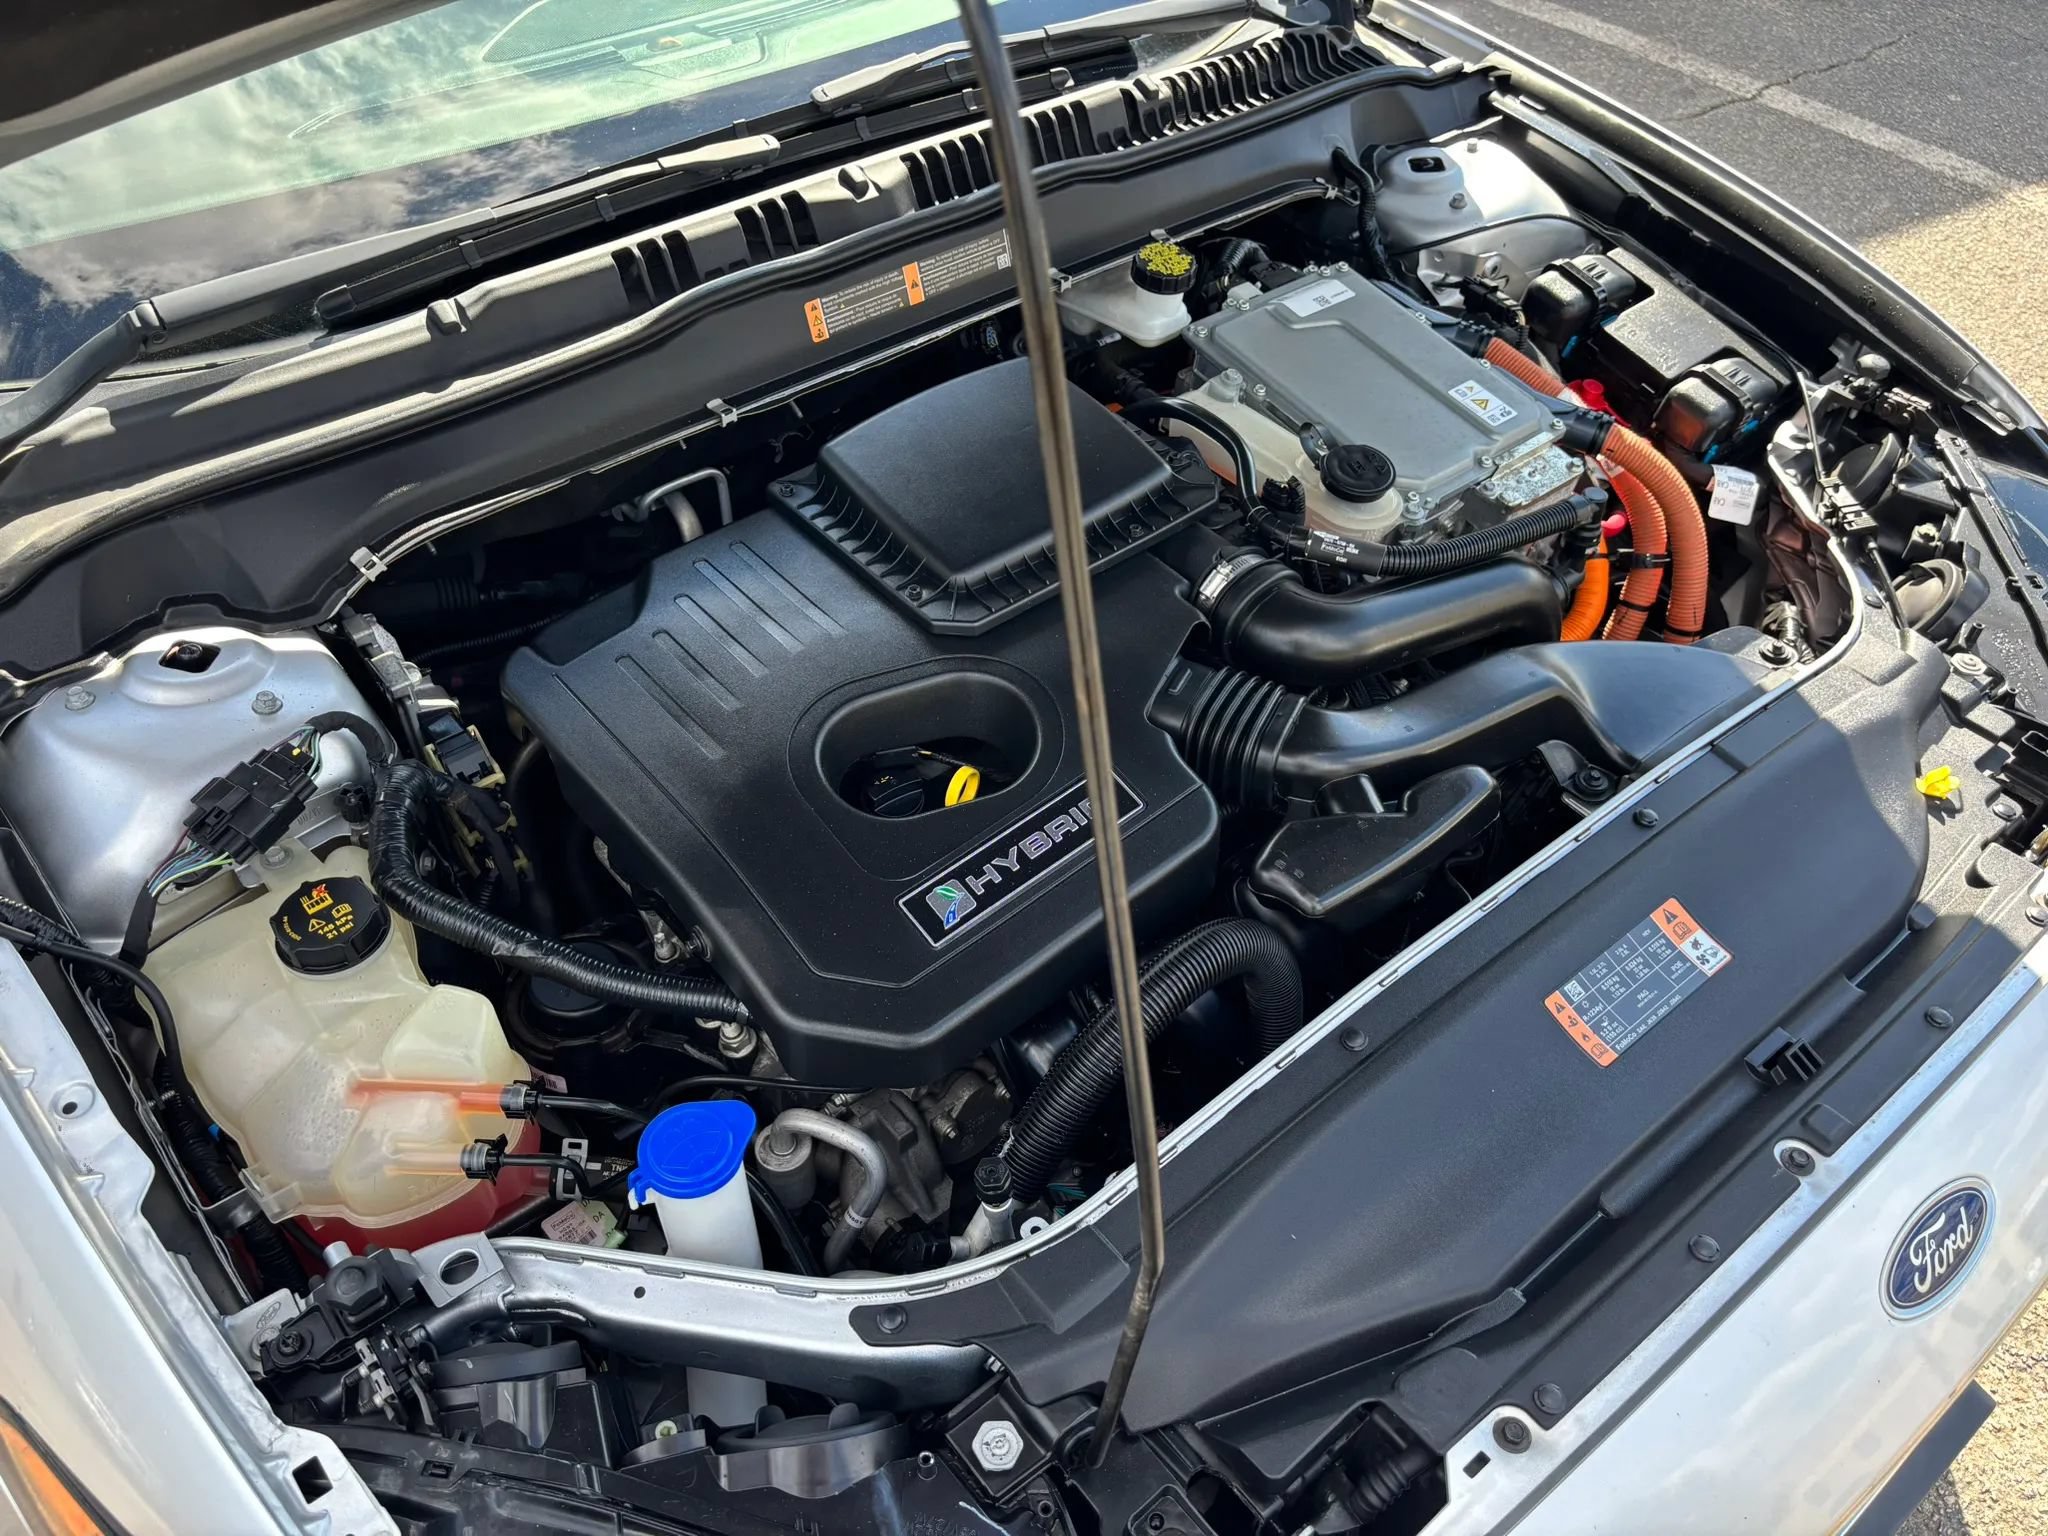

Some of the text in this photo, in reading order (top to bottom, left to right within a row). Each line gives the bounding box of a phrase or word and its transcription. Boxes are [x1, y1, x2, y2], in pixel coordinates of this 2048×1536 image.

[326, 931, 338, 940] 21
[1615, 1032, 1637, 1050] FoMoCo
[592, 1210, 606, 1223] DA
[1909, 1206, 1973, 1293] Ford
